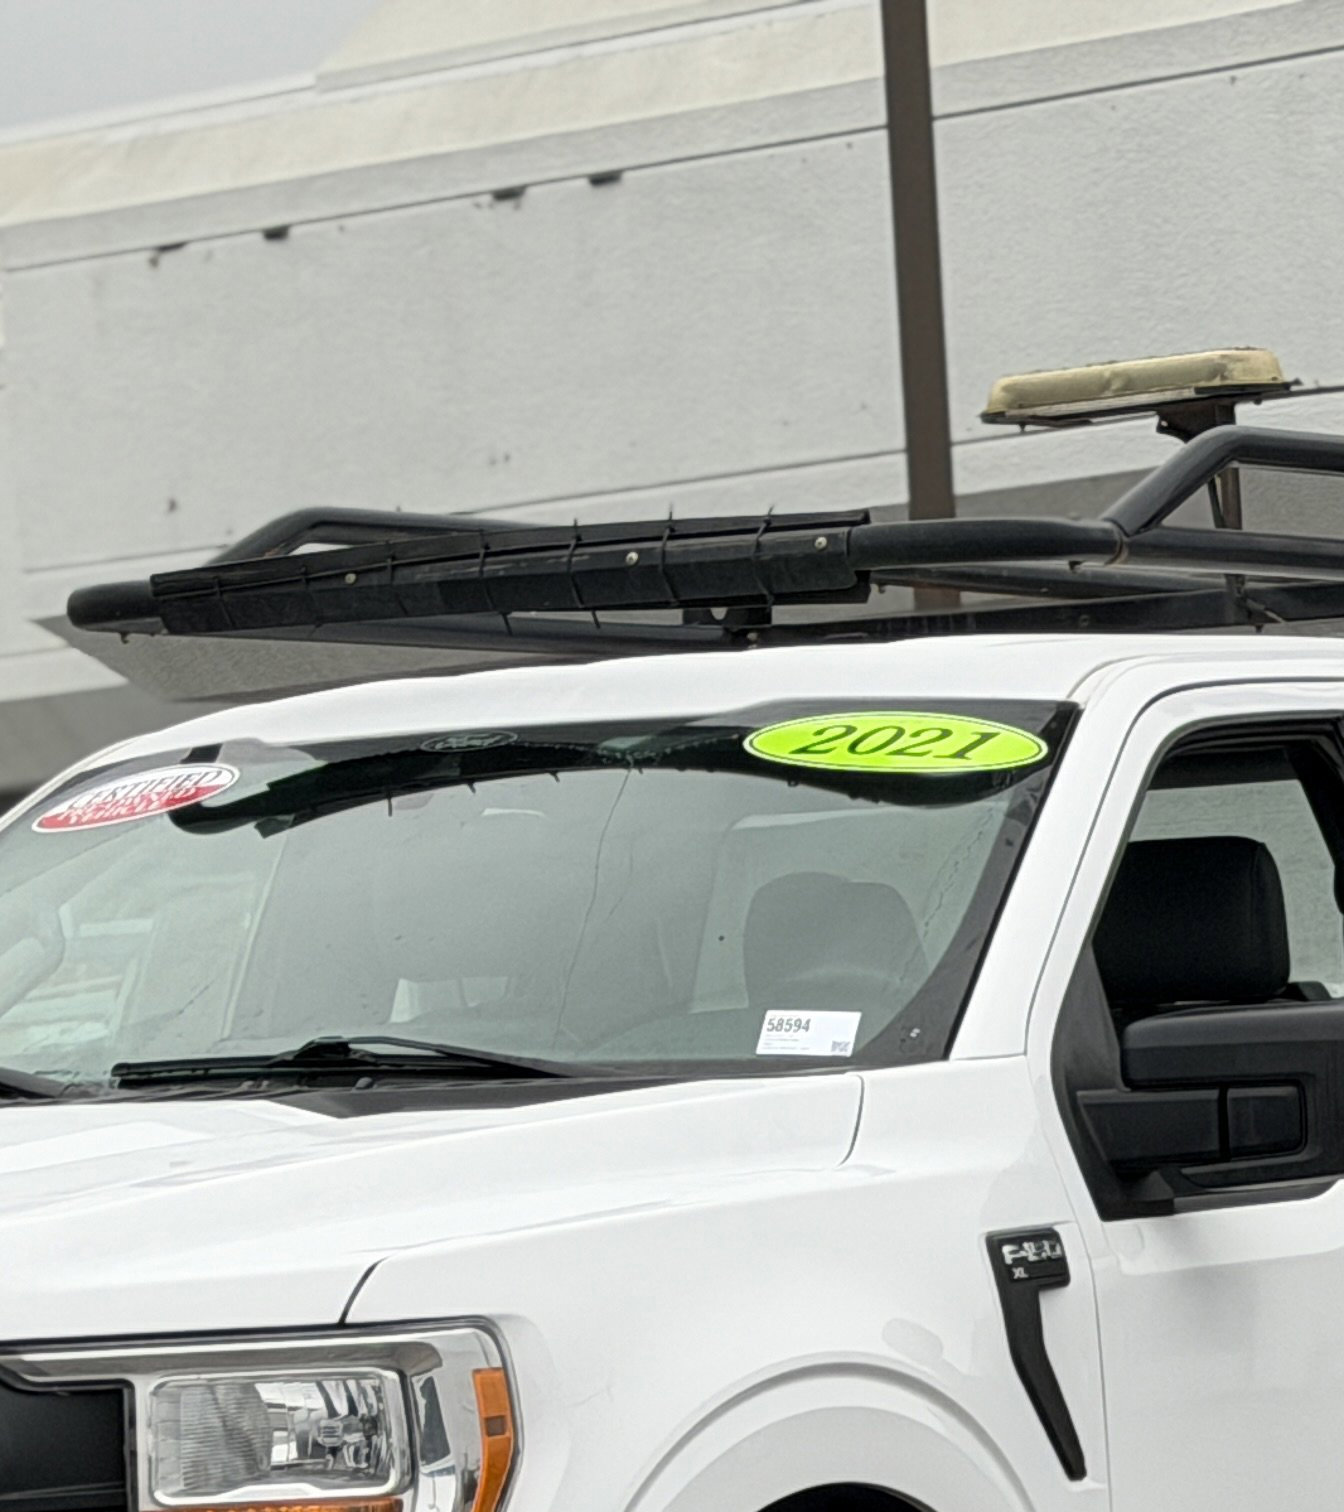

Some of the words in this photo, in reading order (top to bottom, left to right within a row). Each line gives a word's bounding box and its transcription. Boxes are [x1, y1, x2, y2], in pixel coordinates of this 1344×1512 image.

[789, 724, 1001, 760] 2021
[766, 1017, 812, 1033] 58594
[1012, 1266, 1030, 1280] XL
